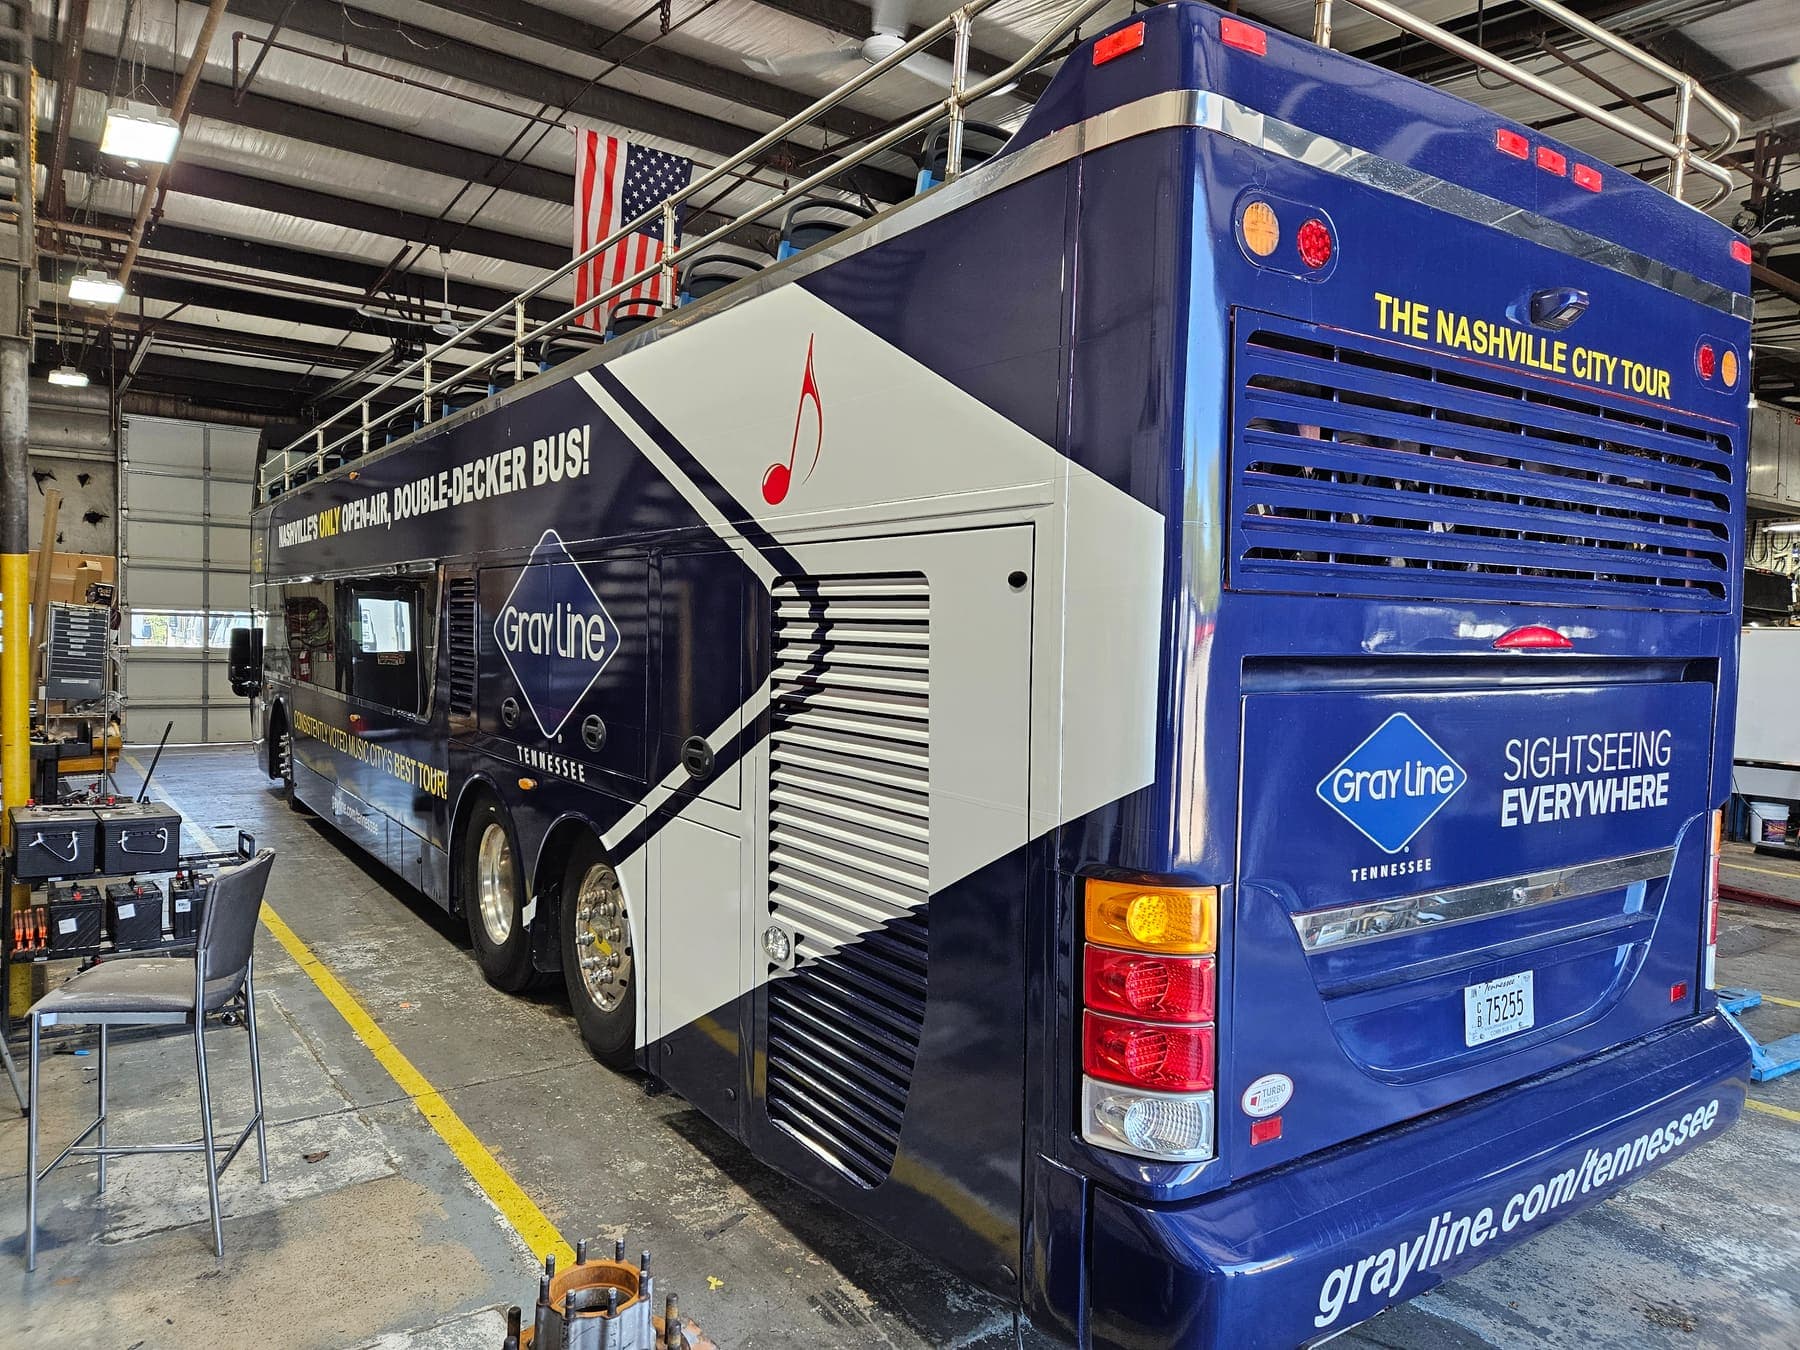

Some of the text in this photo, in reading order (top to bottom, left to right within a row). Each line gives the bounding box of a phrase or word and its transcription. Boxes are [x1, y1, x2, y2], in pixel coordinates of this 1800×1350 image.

[1374, 292, 1671, 400] THE NASHVILLE CITY TOUR
[278, 424, 591, 548] NASHVILLE'S ONLY OPEN-AIR, DOUBLE-DECKER BUS!
[503, 601, 606, 661] Gray Line
[294, 710, 328, 743] CONSISTENTLY
[348, 734, 369, 764] MUSIC
[370, 743, 393, 775] CITY'S
[394, 752, 417, 785] BEST
[417, 762, 449, 800] TOUR!
[516, 744, 586, 783] TENNESSEE
[1503, 729, 1672, 782] SIGHTSEEING
[1333, 761, 1455, 803] Gray Line
[1501, 772, 1670, 828] EVERYWHERE
[1350, 858, 1432, 882] TENNESSEE
[1485, 979, 1515, 994] Tennessee
[1486, 990, 1523, 1025] 75255
[1262, 1083, 1286, 1098] TURBO
[1314, 1099, 1720, 1329] grayline.com/tennessee
